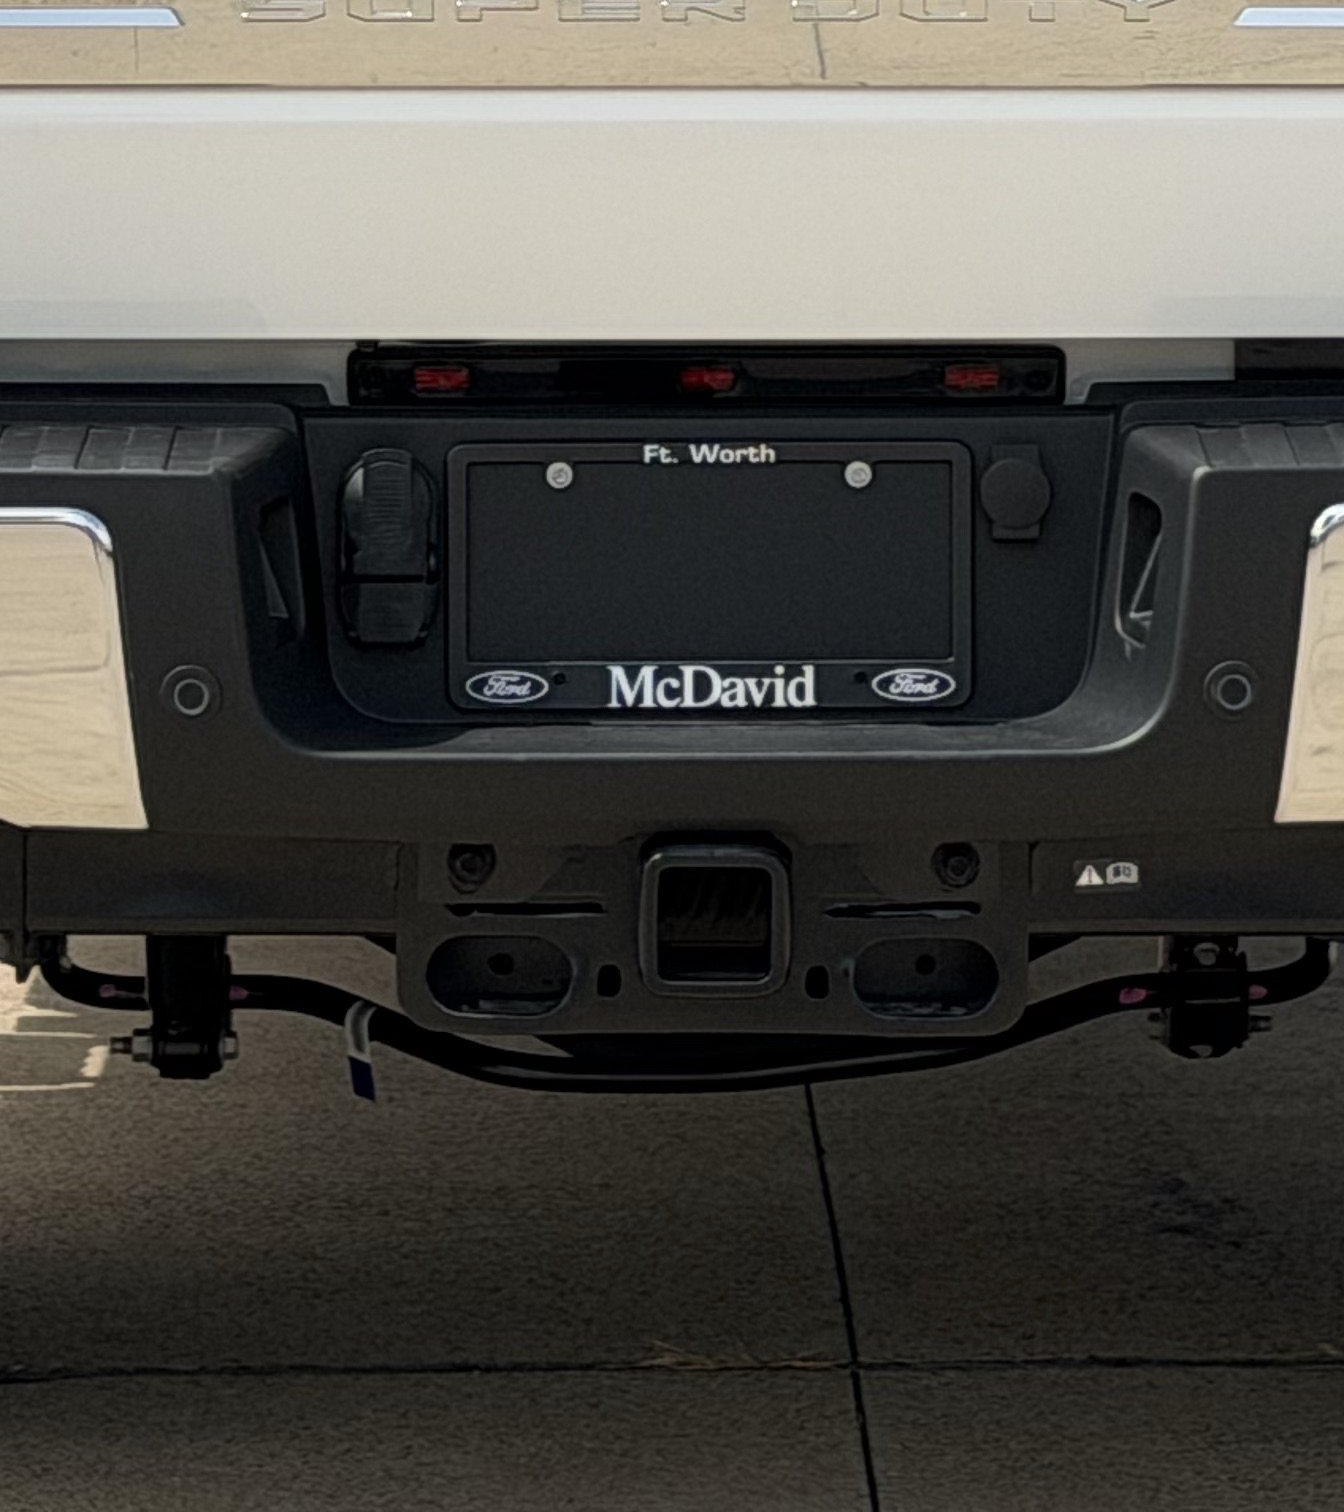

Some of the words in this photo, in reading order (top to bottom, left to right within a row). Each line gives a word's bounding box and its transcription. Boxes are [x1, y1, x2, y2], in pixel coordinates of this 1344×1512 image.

[642, 443, 679, 464] Ft.
[687, 443, 776, 464] Worth
[605, 664, 818, 709] McDavid
